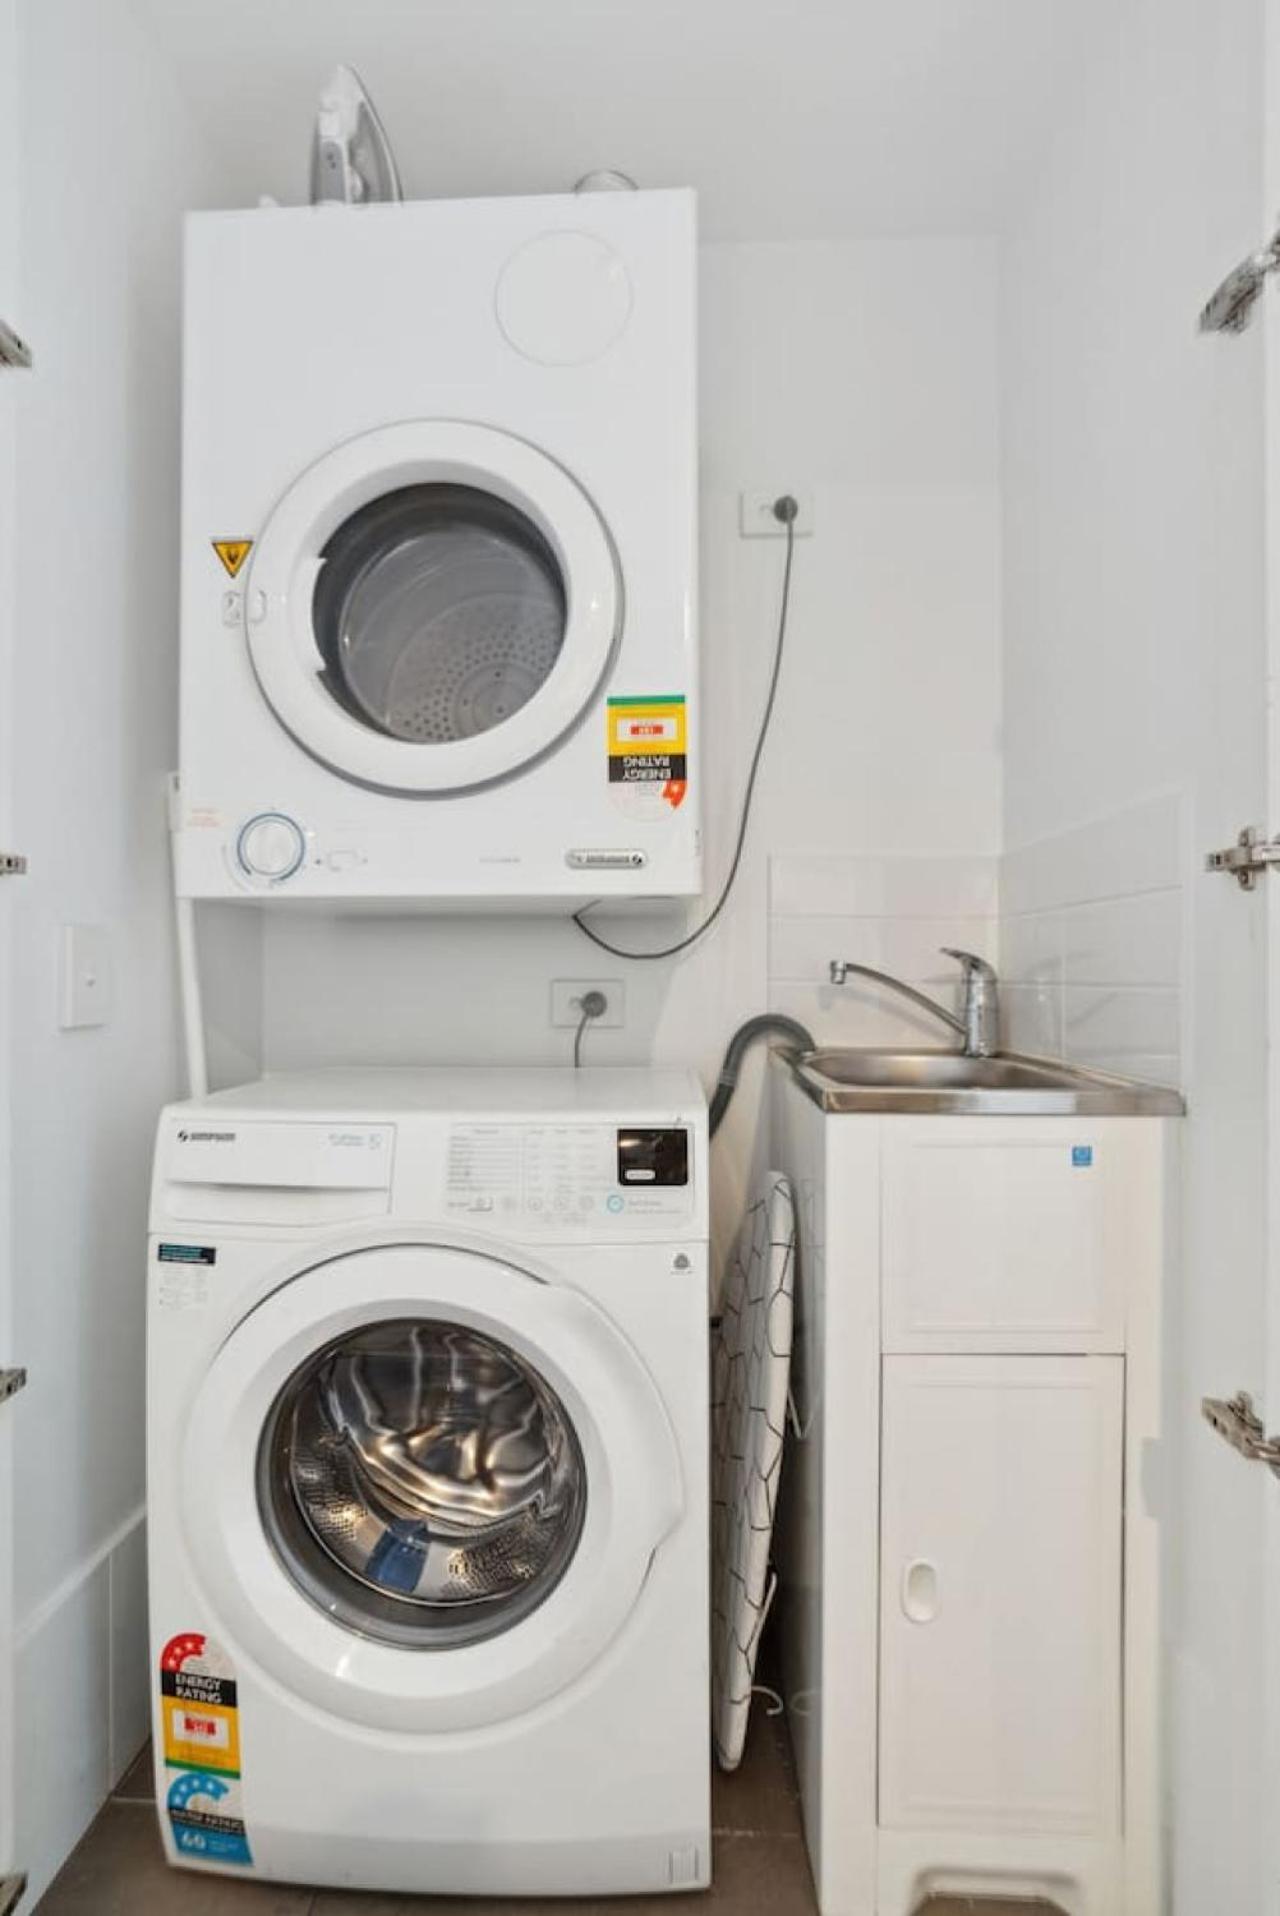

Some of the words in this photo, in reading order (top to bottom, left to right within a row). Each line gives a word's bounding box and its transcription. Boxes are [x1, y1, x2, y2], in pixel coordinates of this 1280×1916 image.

[623, 755, 670, 768] RATING
[622, 768, 672, 781] ENERGY
[175, 1673, 221, 1691] ENERGY
[175, 1686, 222, 1703] RATING
